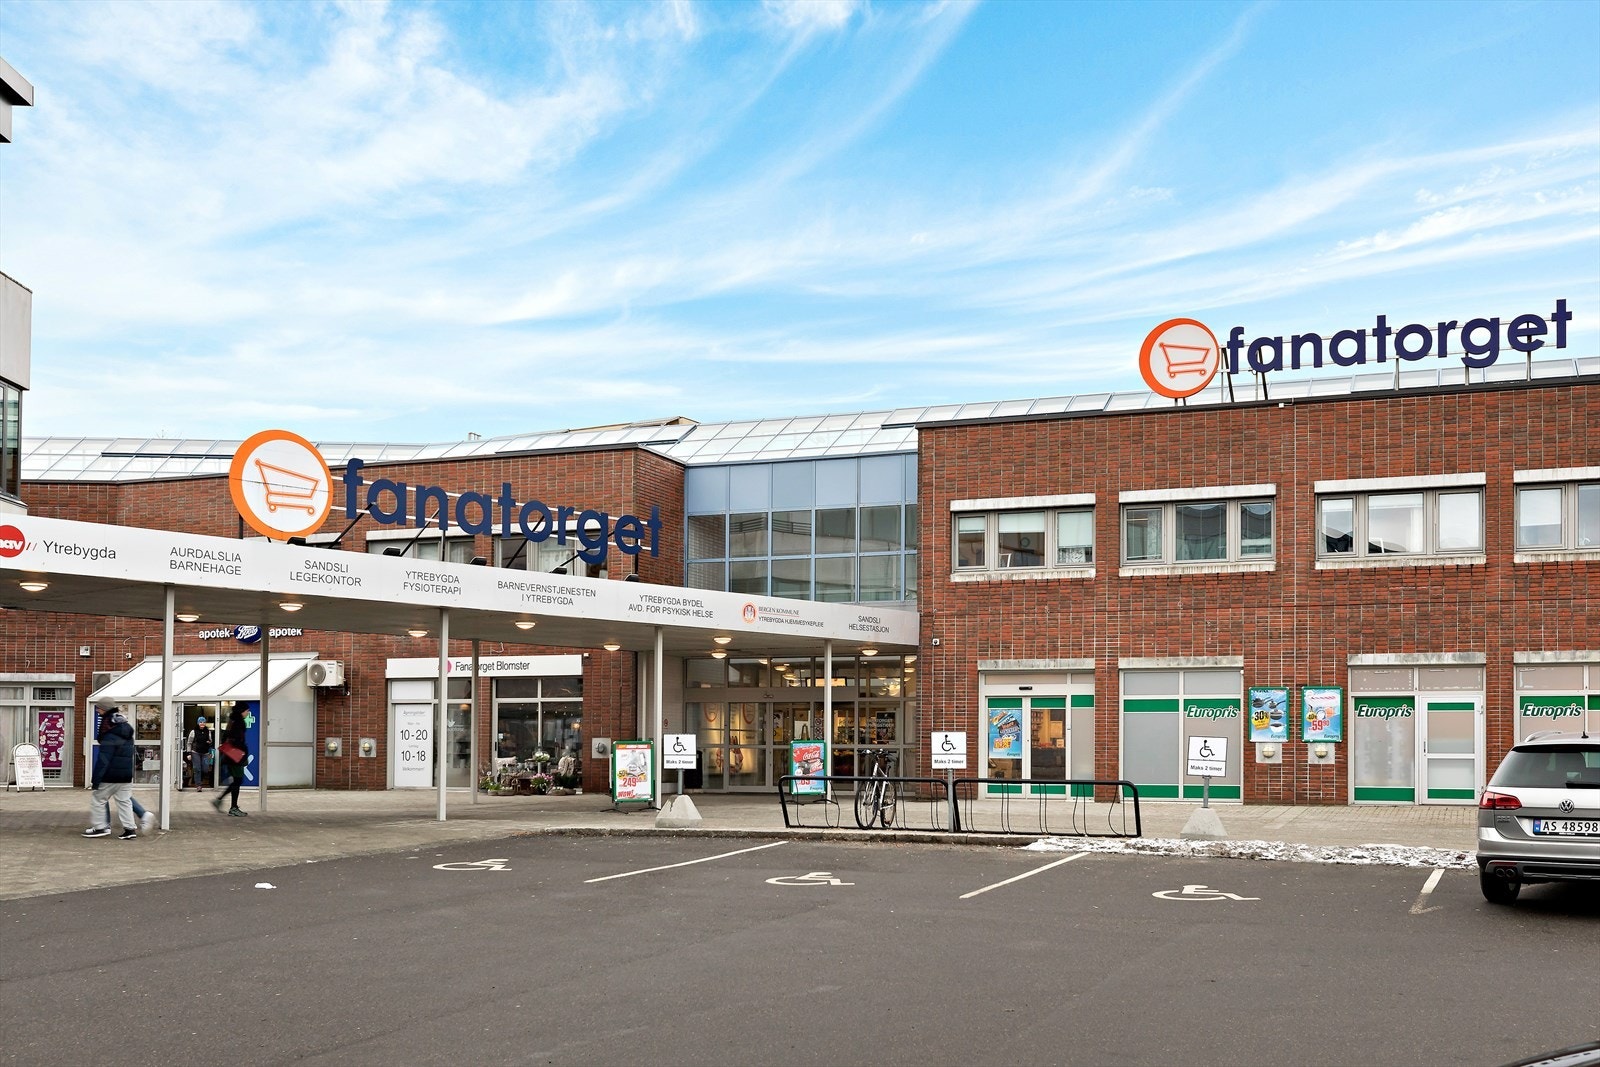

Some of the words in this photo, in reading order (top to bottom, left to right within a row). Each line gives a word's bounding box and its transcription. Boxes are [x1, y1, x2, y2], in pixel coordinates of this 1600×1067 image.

[1227, 298, 1572, 374] fanatorget
[343, 457, 662, 564] fanatorget
[43, 540, 116, 560] Ytrebygda
[170, 547, 242, 562] AURDALSLIA
[170, 560, 242, 575] BARNEHAGE
[304, 560, 349, 573] SANDSLI
[289, 571, 361, 586] LEGEKONTOR
[406, 570, 460, 584] YTREBYGDA
[403, 582, 461, 595] FYSIOTERAPI
[497, 581, 596, 597] BARNEVERNSTJENESTEN
[525, 594, 573, 605] YTREBYGDA
[639, 595, 681, 606] YTREBYGDA
[683, 599, 704, 608] BYDEL
[628, 604, 645, 612] AVD.
[646, 605, 661, 613] FOR
[662, 607, 691, 616] PSYKISK
[692, 609, 713, 618] HELSE
[759, 616, 785, 624] YTREBYGDA
[858, 615, 881, 623] SANDSLI
[268, 627, 302, 638] apotek
[848, 623, 889, 633] HELSESTASJON
[455, 661, 495, 673] Fanarget
[496, 660, 530, 672] Blomster
[1187, 705, 1238, 721] Europris
[1357, 704, 1413, 721] Europris
[1522, 703, 1582, 721] Europris
[1543, 821, 1557, 831] AS
[1562, 821, 1599, 832] 48598
